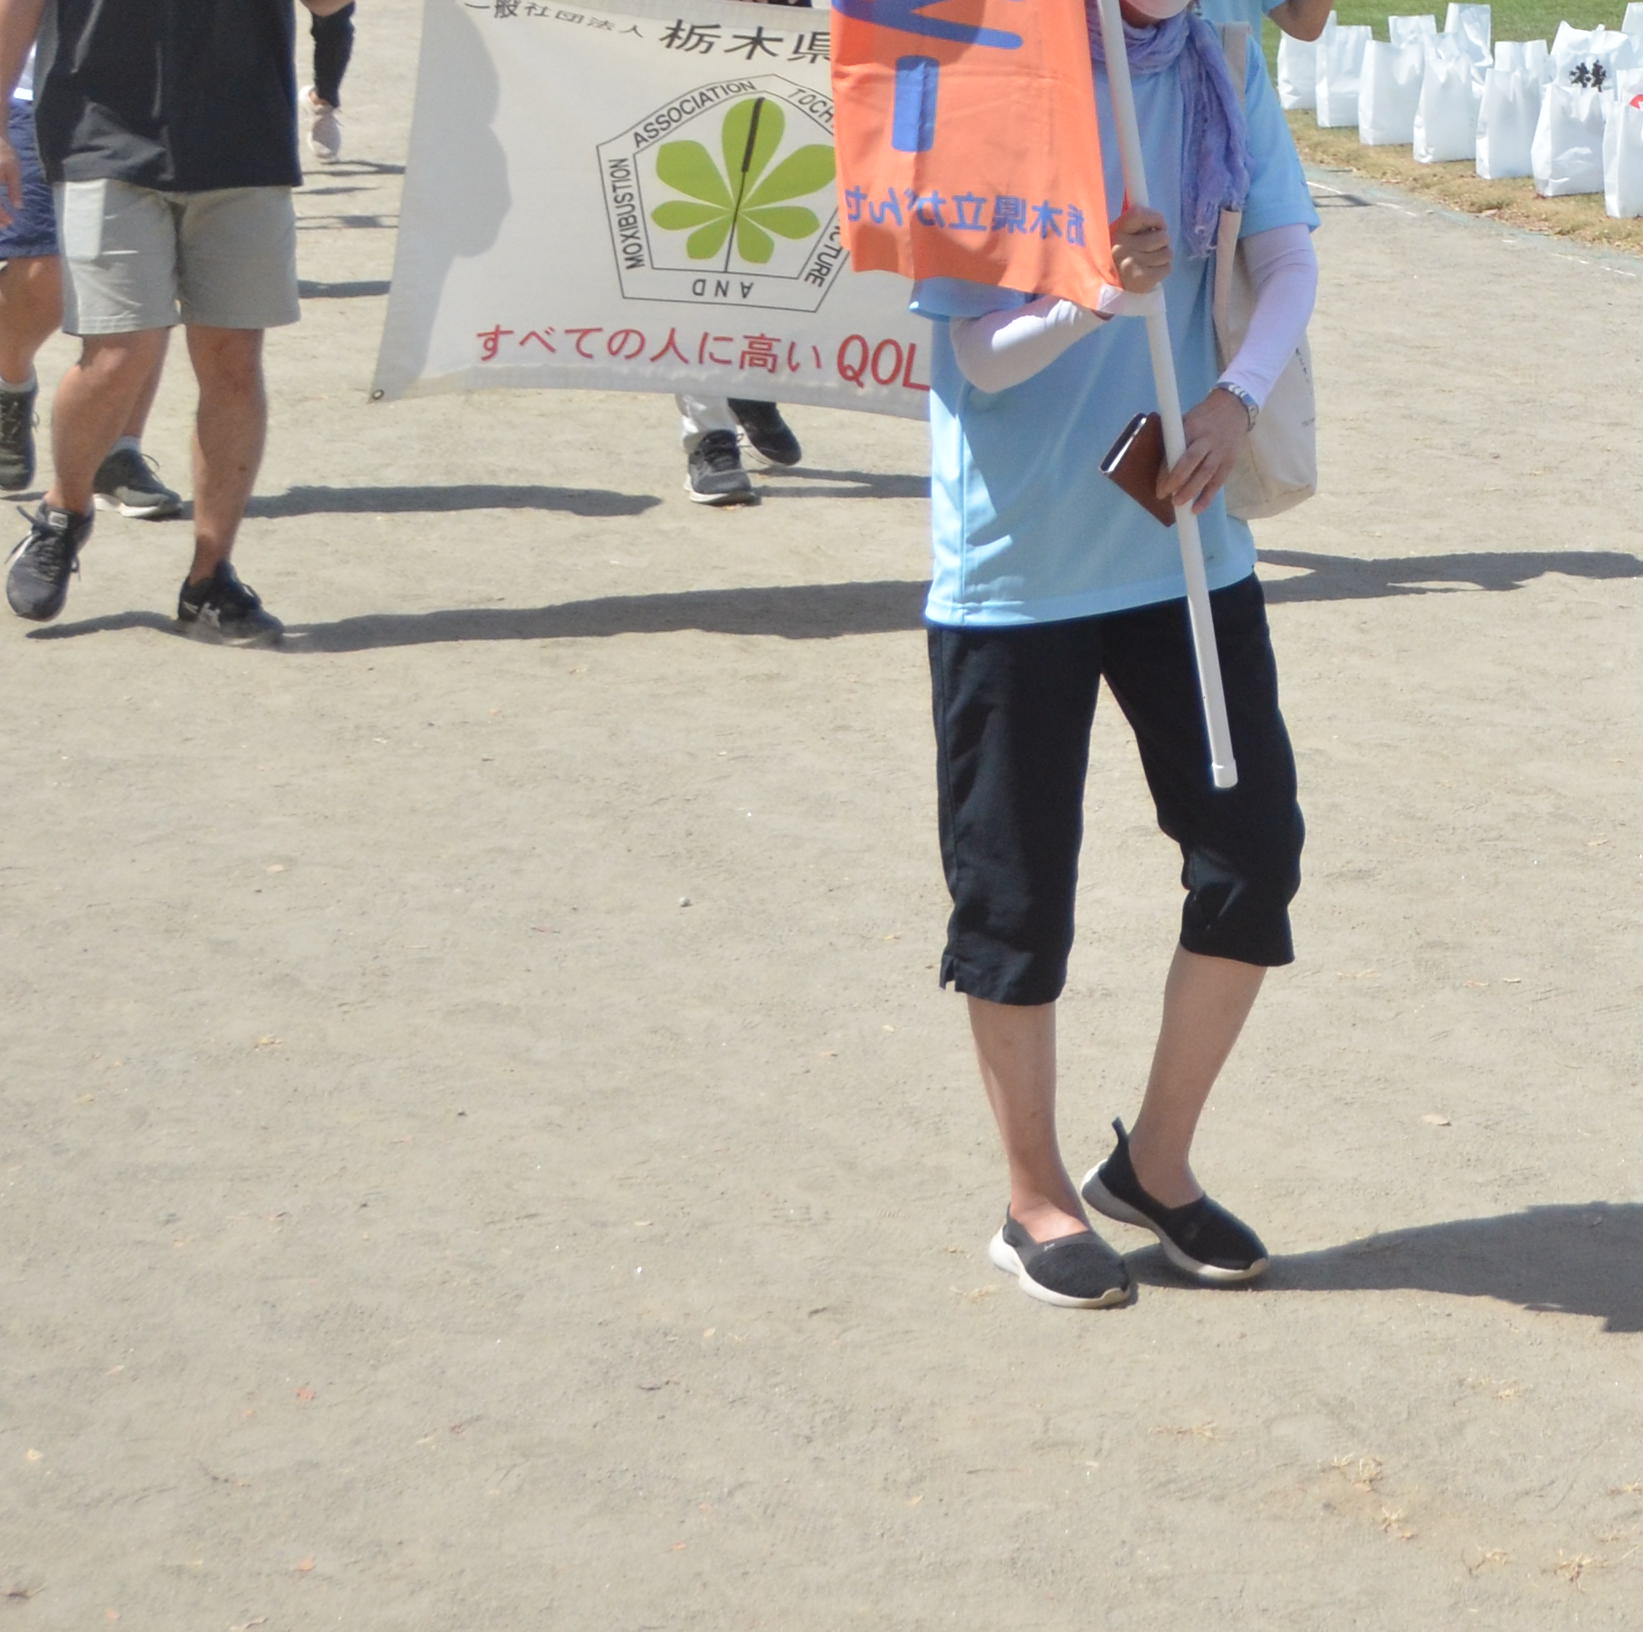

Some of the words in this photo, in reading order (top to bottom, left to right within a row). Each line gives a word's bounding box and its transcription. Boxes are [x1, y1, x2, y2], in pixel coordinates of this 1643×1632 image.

[632, 79, 757, 149] ASSOCIATION
[608, 156, 646, 271] MOXIBUSTION
[691, 278, 755, 301] AND
[475, 323, 822, 374] すべての人に高い
[836, 334, 931, 392] QOL
